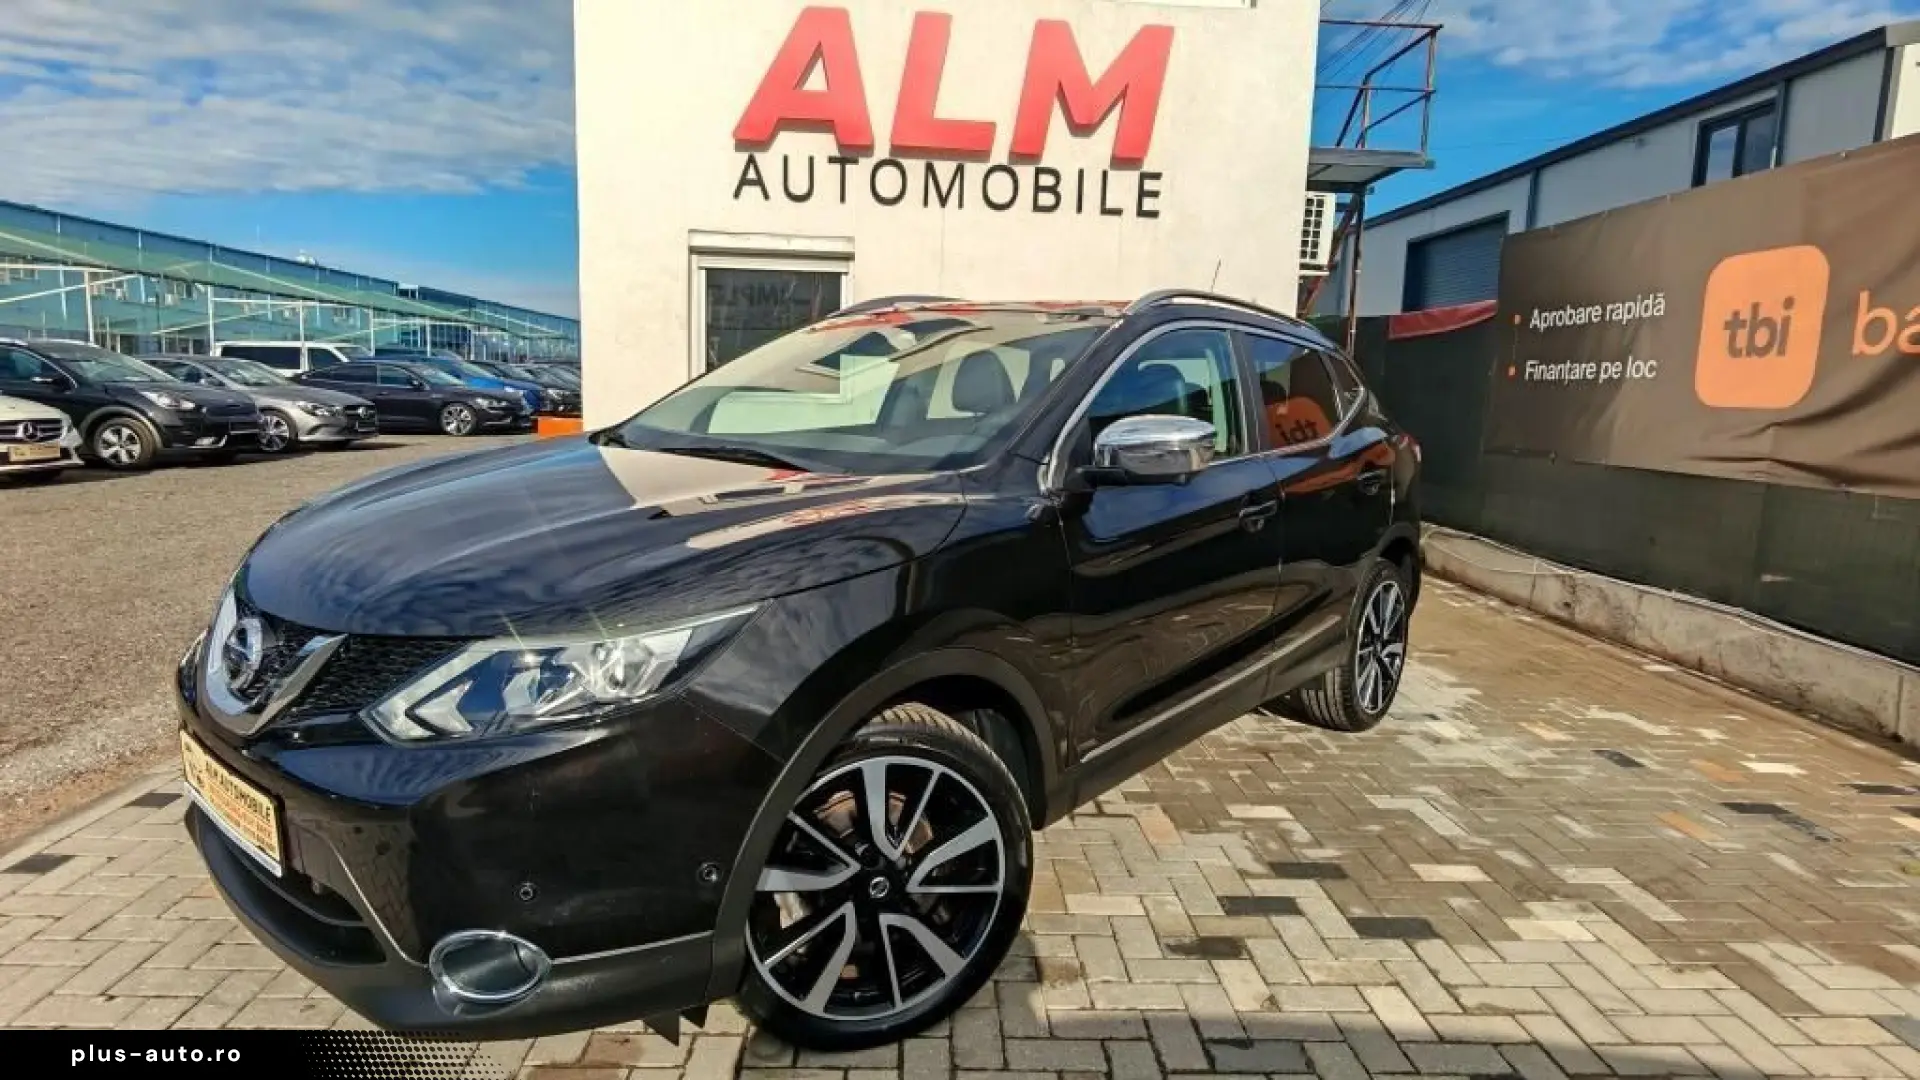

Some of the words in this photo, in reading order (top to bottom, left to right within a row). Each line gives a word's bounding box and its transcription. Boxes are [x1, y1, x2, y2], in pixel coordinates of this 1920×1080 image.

[733, 6, 1174, 169] ALM
[734, 153, 1162, 218] AUTOMOBILE
[1530, 304, 1602, 332] Aprobare
[1607, 291, 1665, 323] rapidă
[1723, 296, 1794, 359] tbi
[1599, 360, 1622, 383] pe
[1626, 356, 1657, 379] loc
